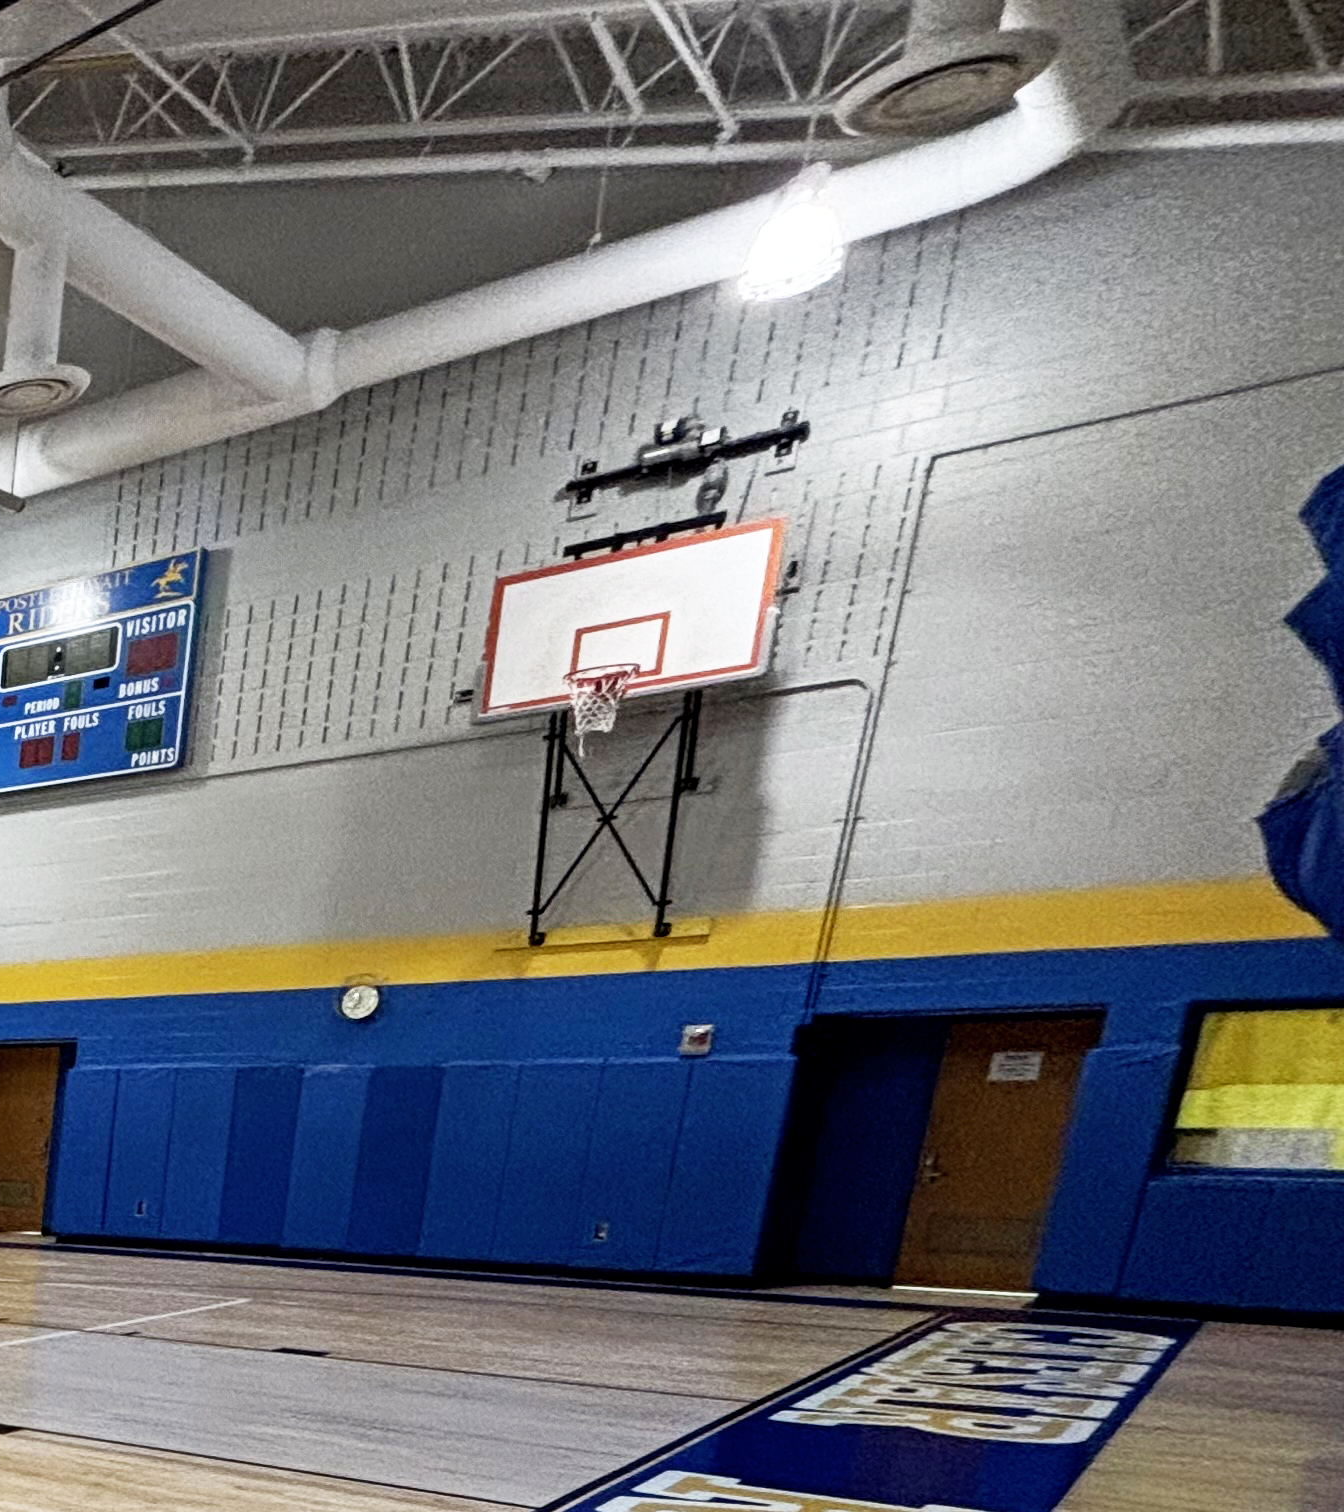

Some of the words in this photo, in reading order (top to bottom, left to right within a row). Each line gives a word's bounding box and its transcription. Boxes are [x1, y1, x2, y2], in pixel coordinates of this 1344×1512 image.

[8, 593, 110, 636] RIDERS
[126, 609, 187, 637] VISITOR
[118, 677, 159, 698] BONUS
[24, 697, 60, 715] PERIOD
[127, 700, 166, 720] FOULS
[14, 720, 56, 740] PLAYER
[63, 712, 99, 732] FOULS
[131, 748, 175, 768] POINTS
[767, 1321, 1178, 1445] CAESAR
